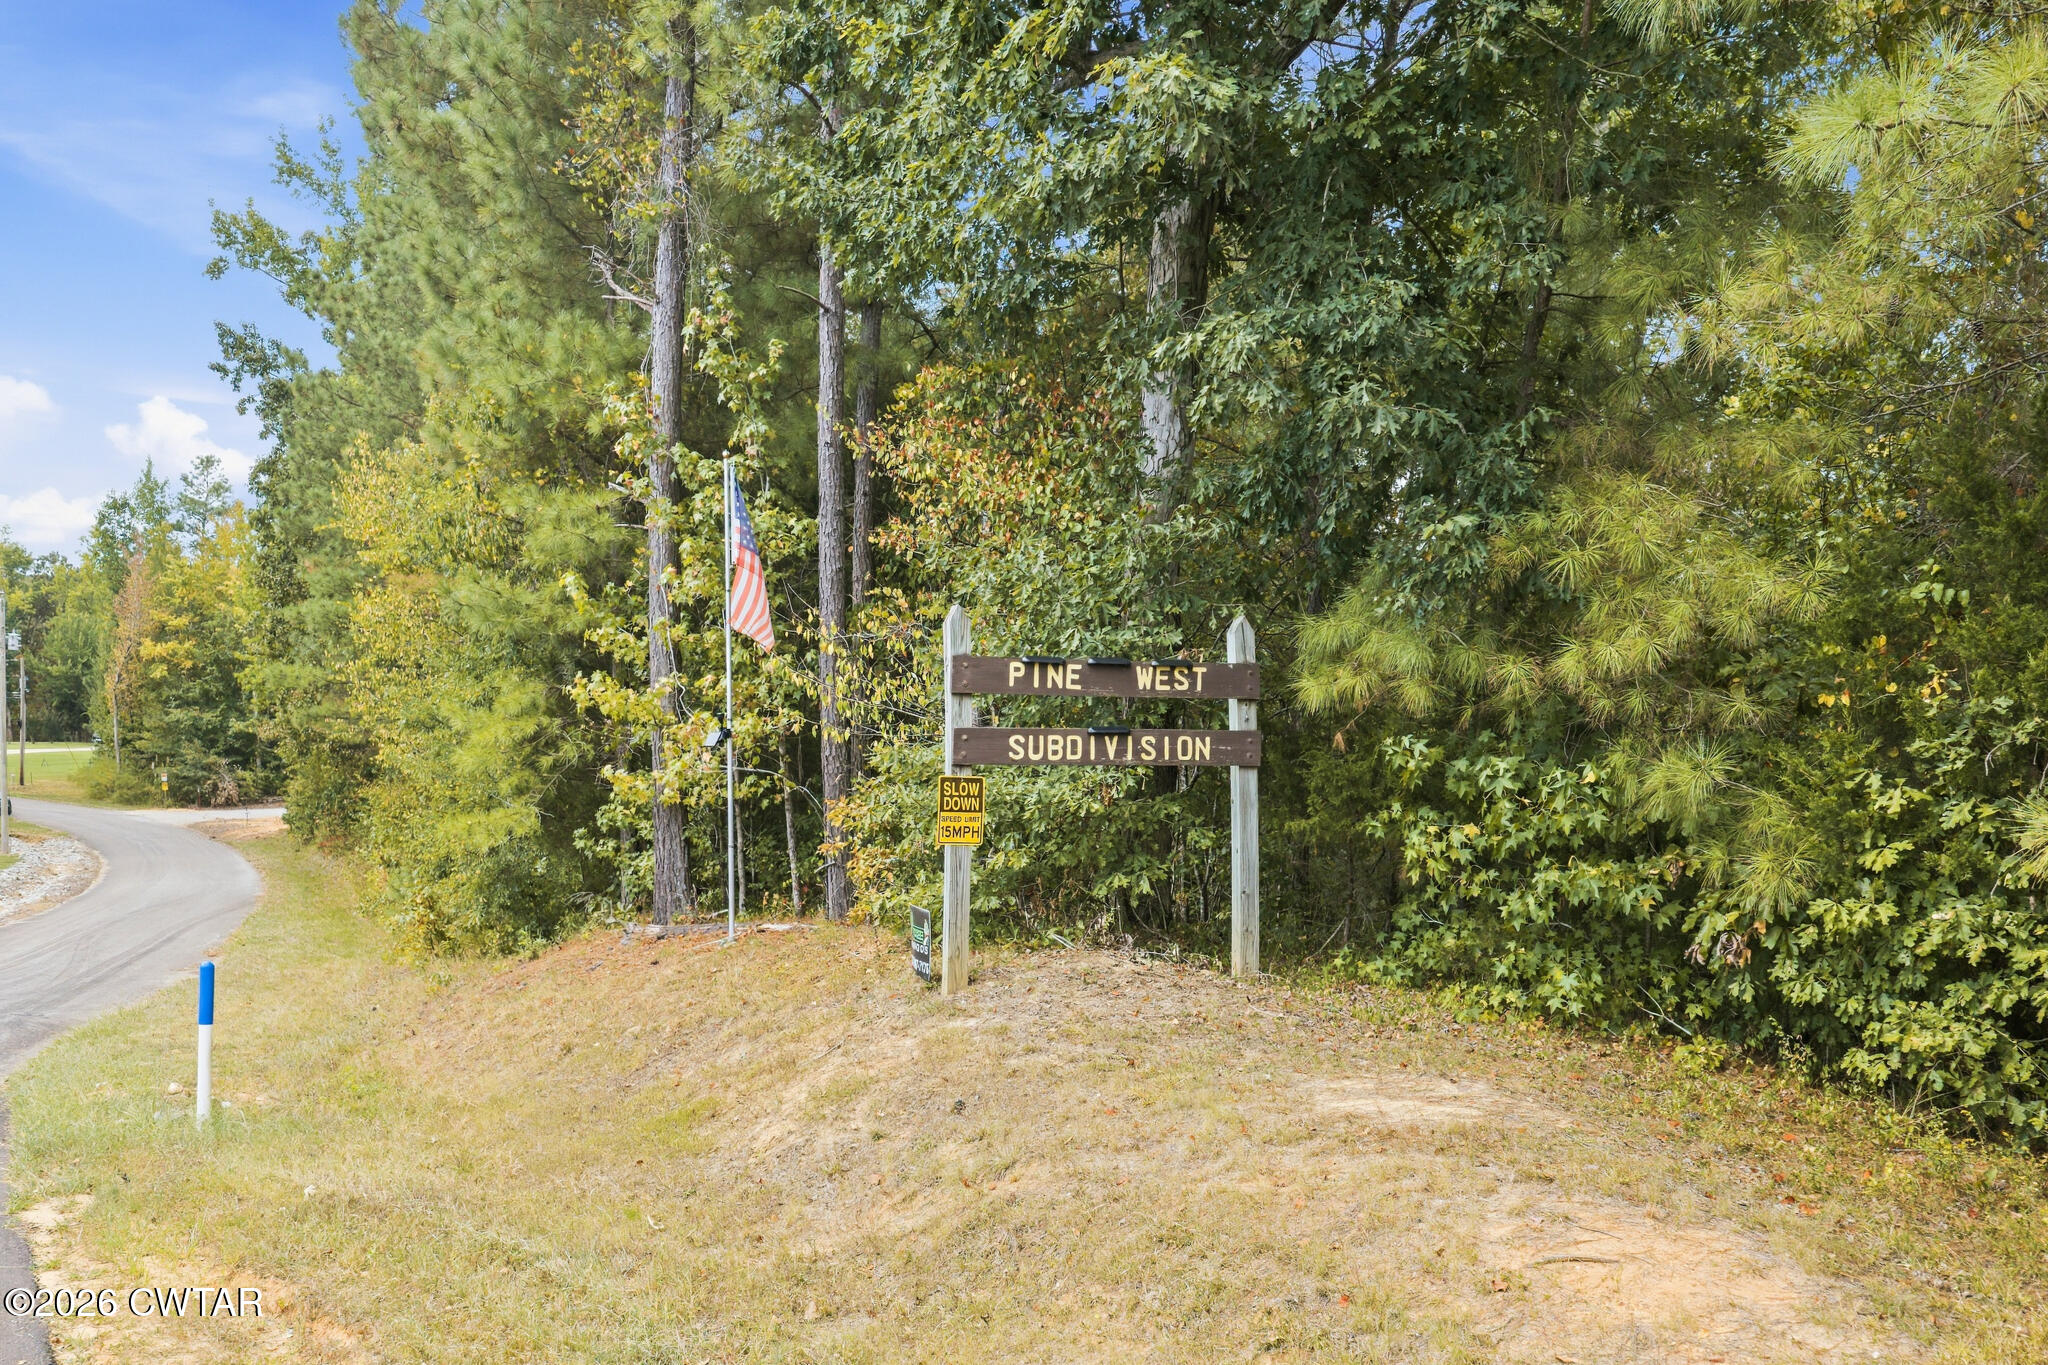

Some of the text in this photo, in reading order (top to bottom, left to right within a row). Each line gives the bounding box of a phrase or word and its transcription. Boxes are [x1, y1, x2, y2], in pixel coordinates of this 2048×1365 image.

[1008, 661, 1207, 692] PINE WEST
[1008, 733, 1212, 761] SUBDIVISION
[943, 781, 980, 796] SLOW
[943, 796, 980, 811] DOWN
[941, 815, 962, 823] SPEED
[941, 825, 980, 839] 15MPH
